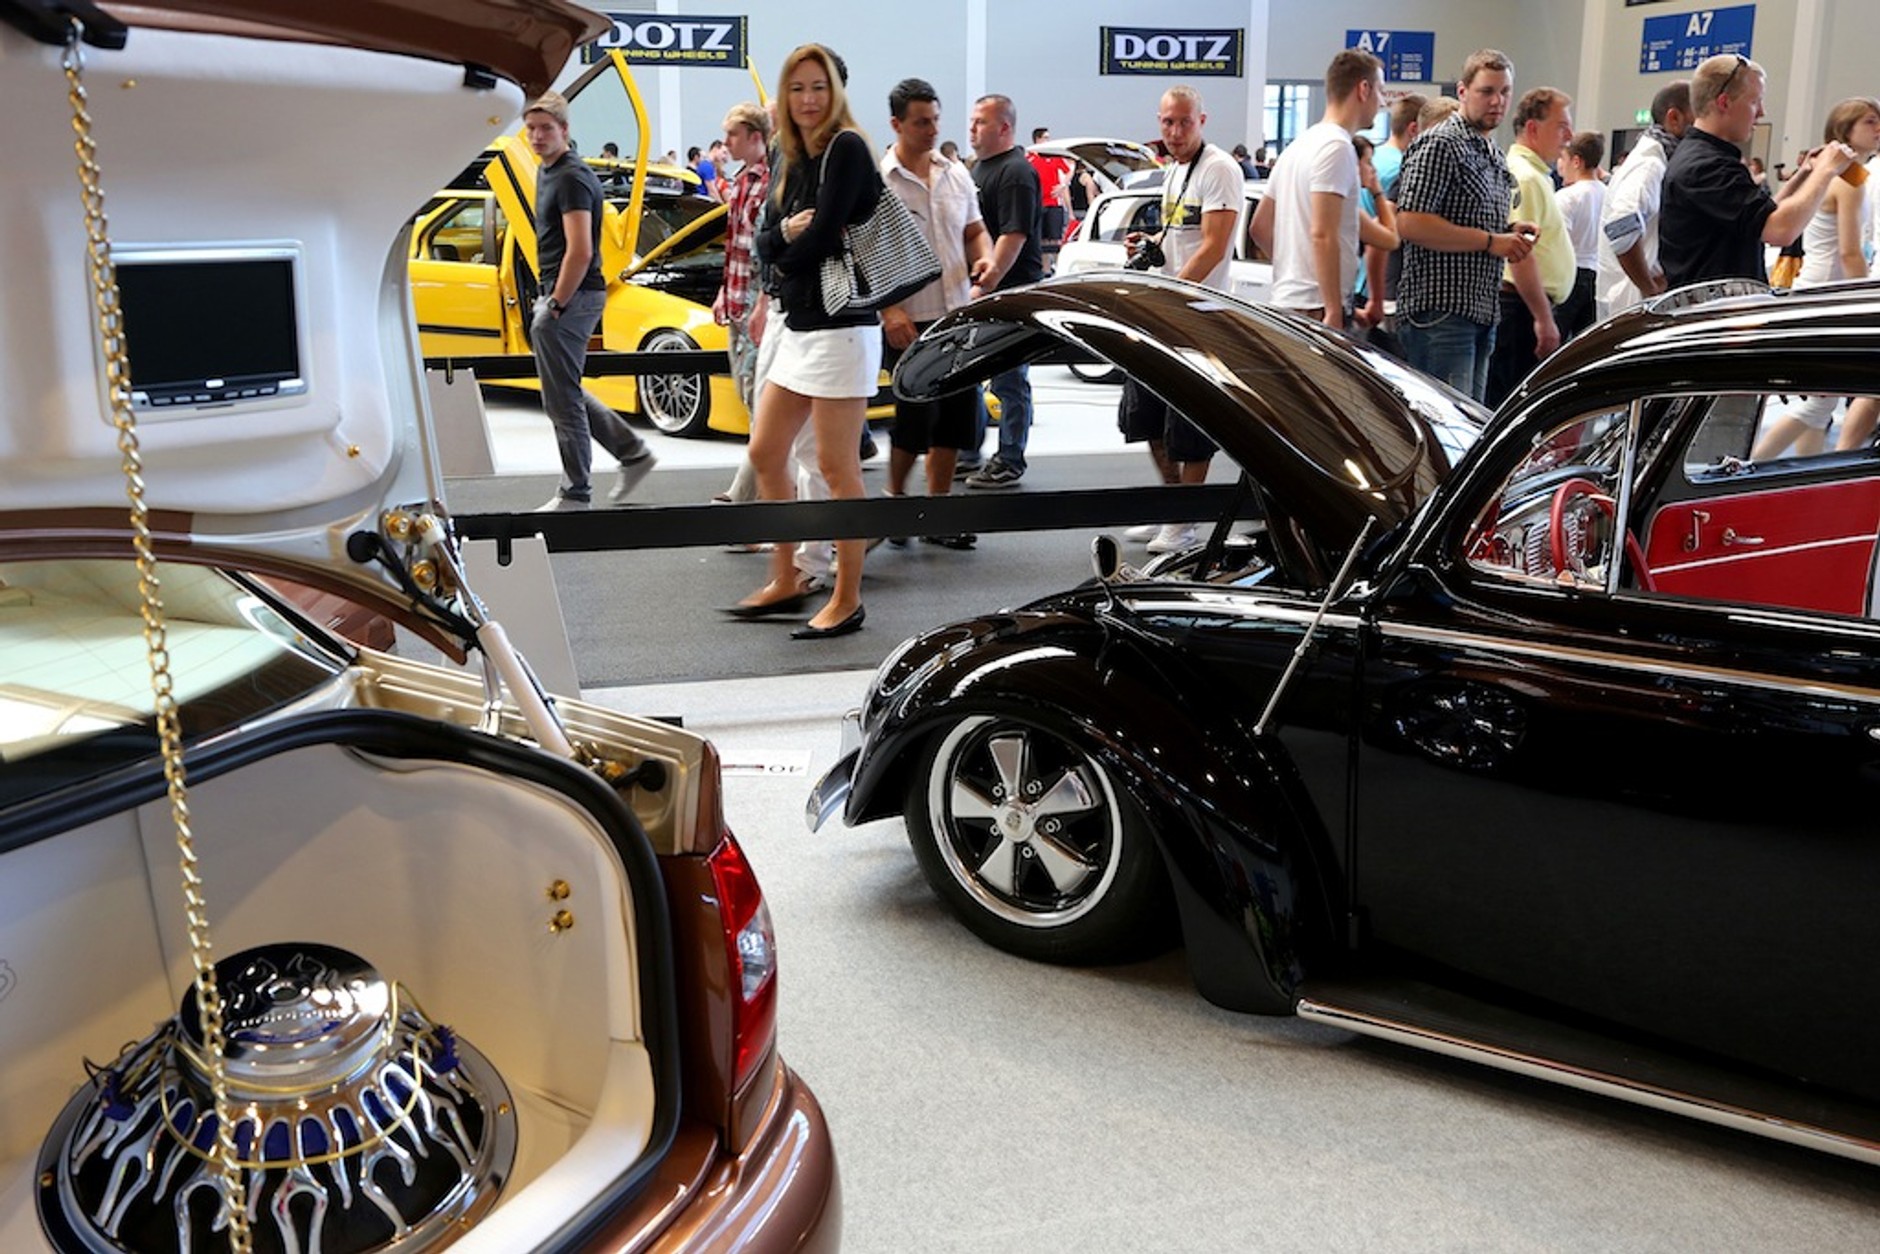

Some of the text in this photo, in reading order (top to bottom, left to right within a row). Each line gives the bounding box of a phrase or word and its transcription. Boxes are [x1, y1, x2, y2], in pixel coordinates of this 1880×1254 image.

[597, 21, 733, 49] DOTZ
[1686, 11, 1714, 37] A7
[1114, 34, 1231, 60] DOTZ
[1357, 31, 1390, 52] A7
[664, 50, 727, 60] WHEELS
[1120, 61, 1226, 70] TUNING WHEELS
